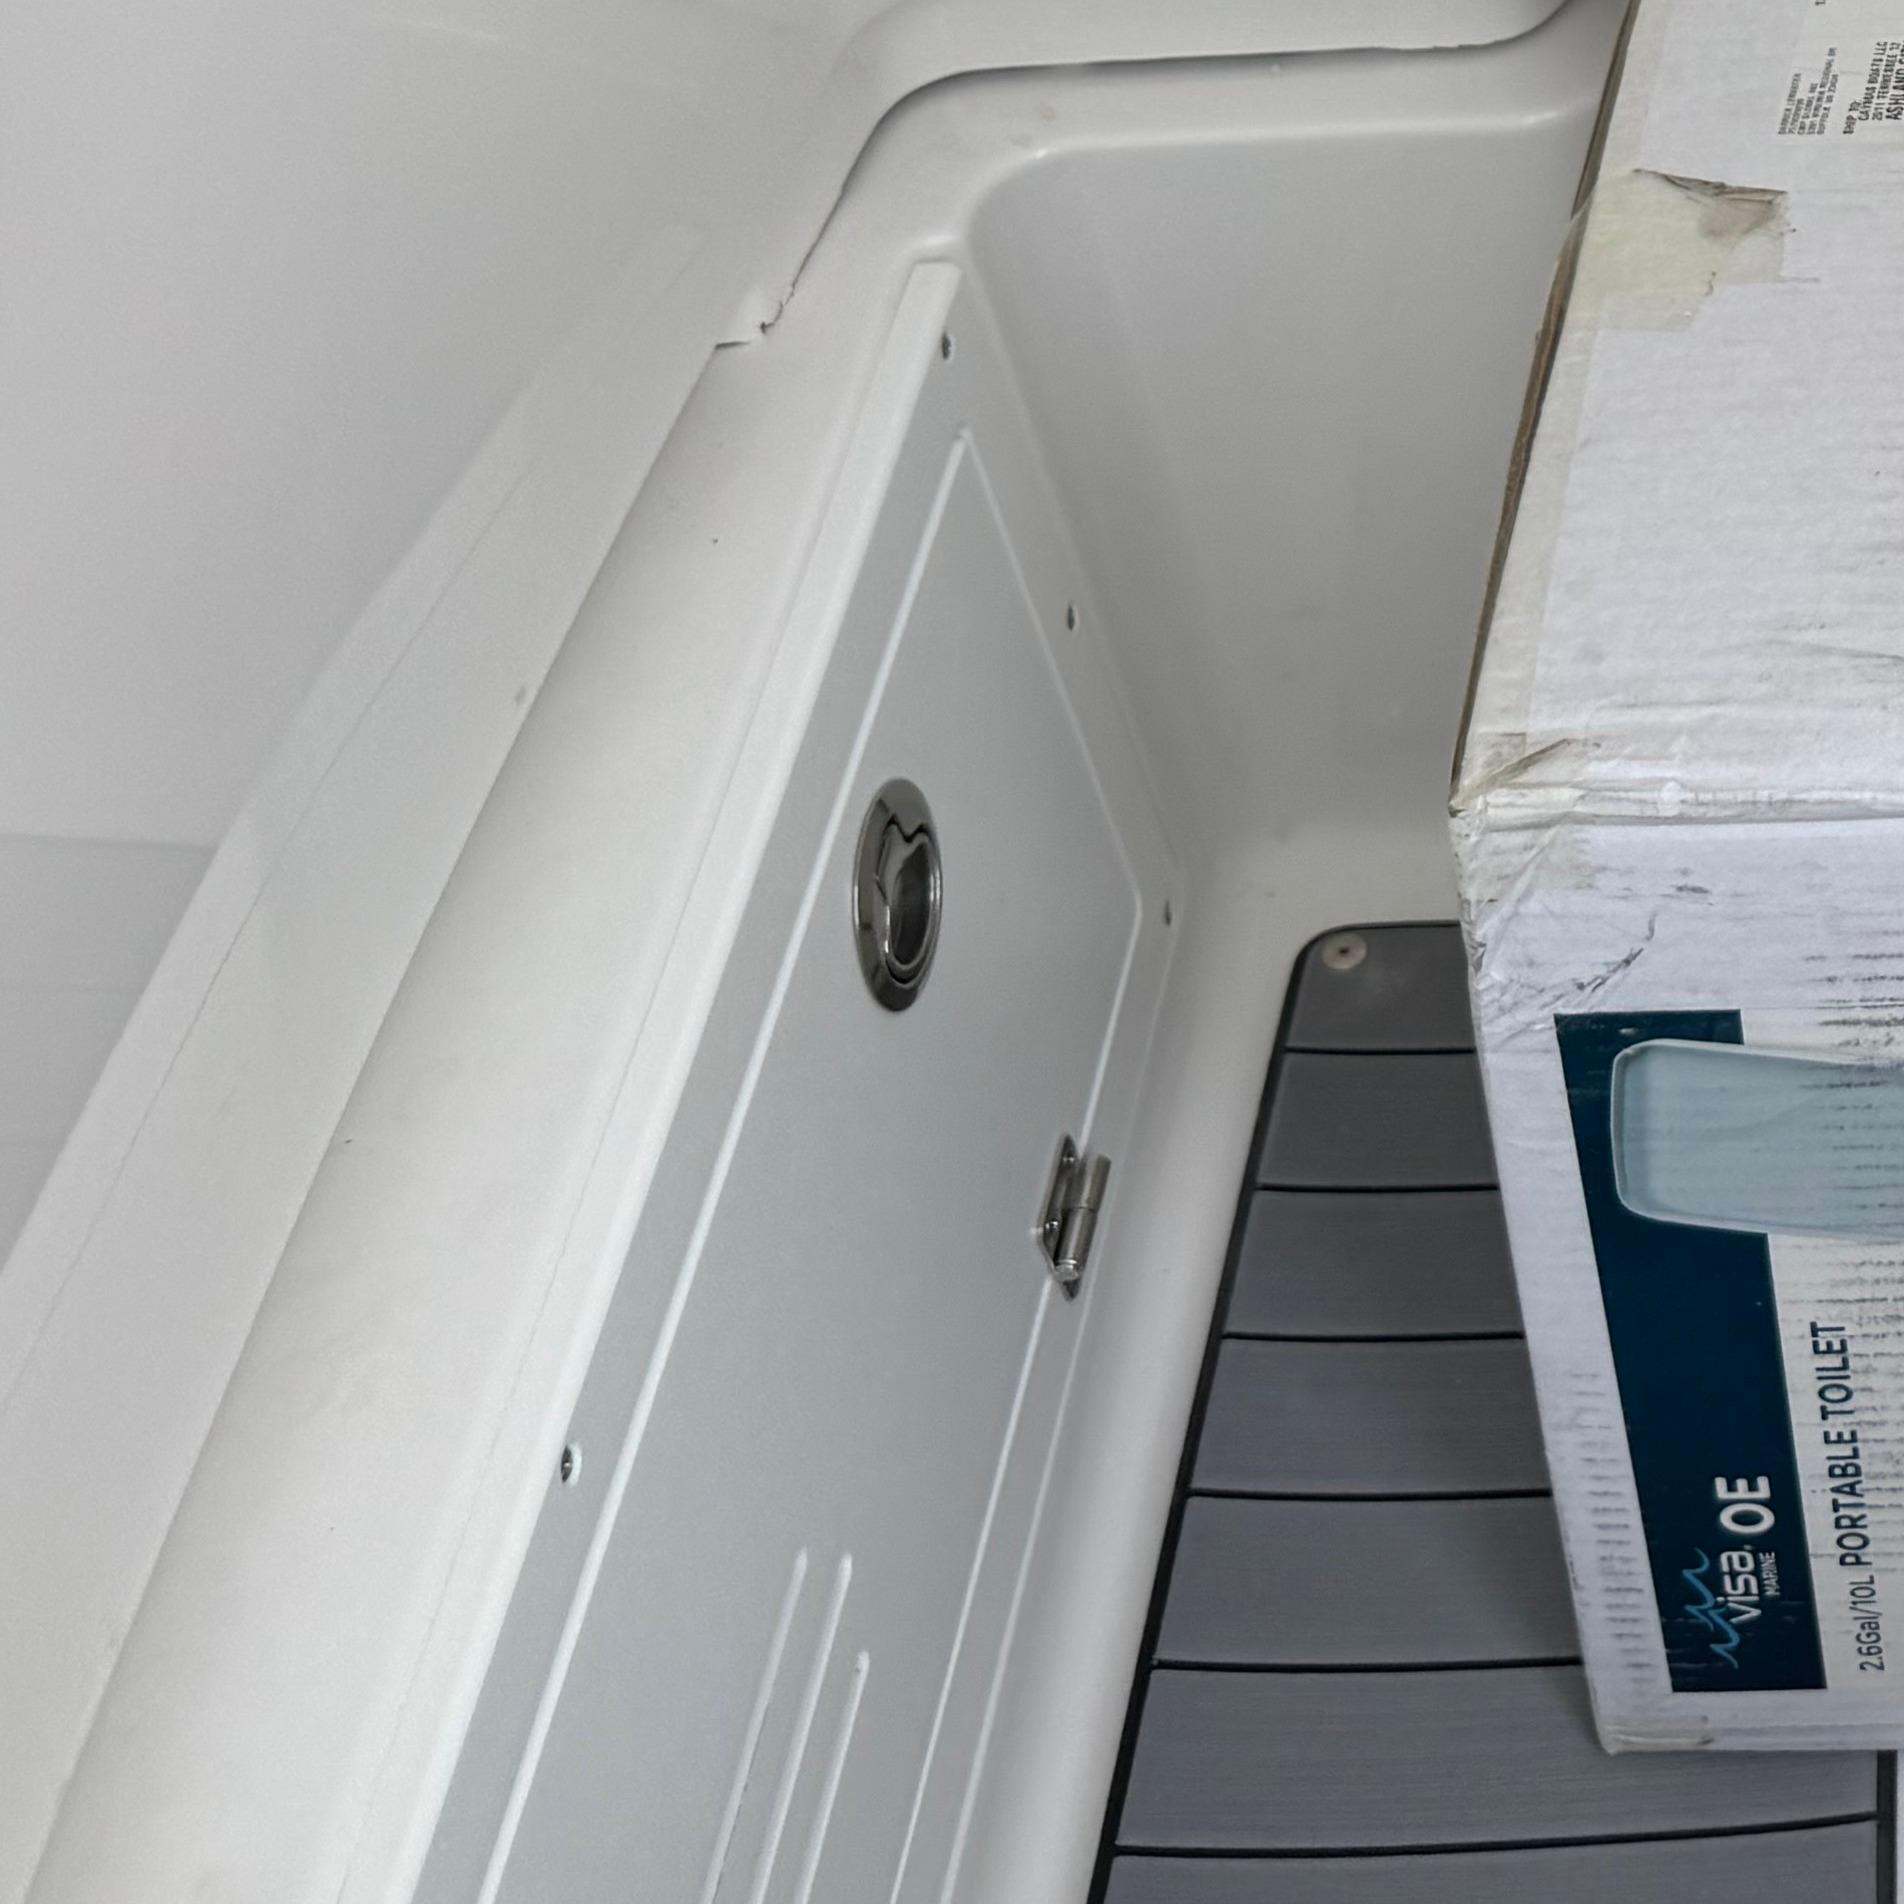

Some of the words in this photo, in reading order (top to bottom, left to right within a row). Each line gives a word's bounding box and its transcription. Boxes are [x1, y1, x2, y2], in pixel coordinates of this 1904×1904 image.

[1810, 1320, 1855, 1421] TOILET
[1714, 1476, 1775, 1535] OE
[1824, 1430, 1874, 1567] PORTABLE
[1759, 1551, 1780, 1596] MARINE
[1848, 1575, 1885, 1672] 2.6Gal/10L
